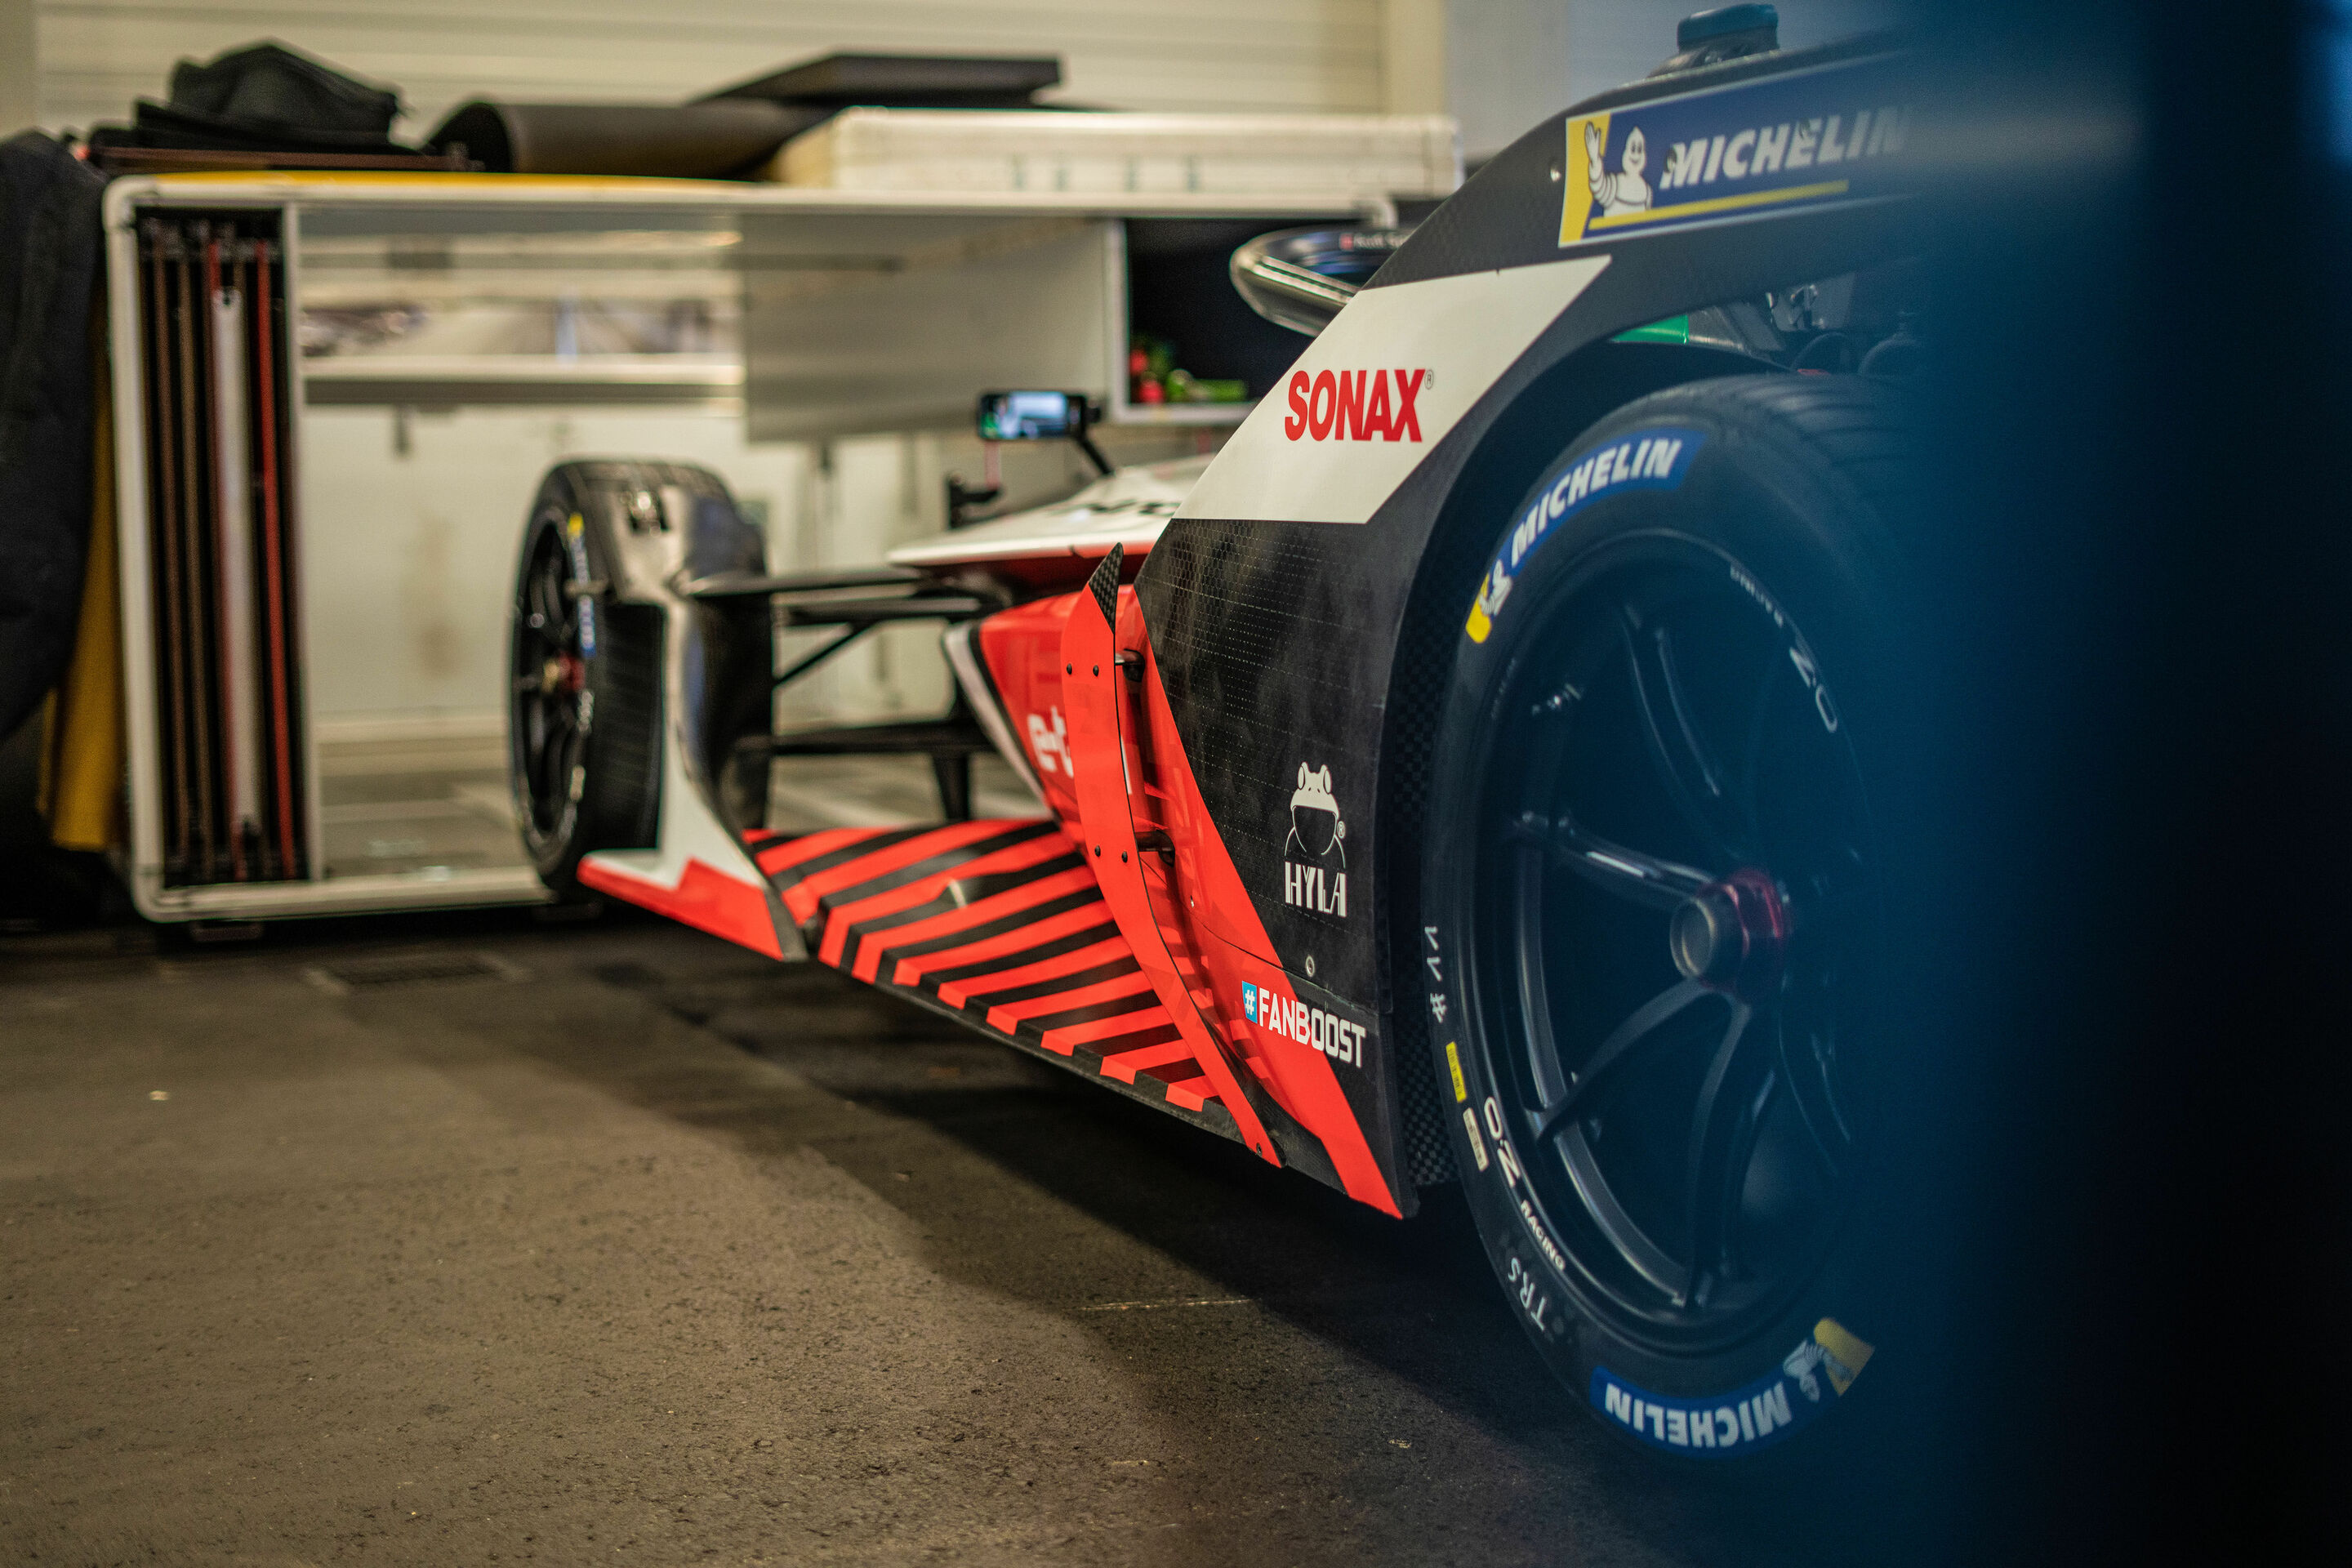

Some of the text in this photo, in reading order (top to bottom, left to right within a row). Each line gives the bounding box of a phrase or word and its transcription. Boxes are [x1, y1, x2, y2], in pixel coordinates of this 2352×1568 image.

[1659, 106, 1909, 190] MICHELIN
[1511, 439, 1682, 568] MICHELIN
[1284, 861, 1348, 918] HYLA
[1520, 1199, 1566, 1271] RACING
[1507, 1256, 1548, 1332] TRS
[1604, 1380, 1793, 1449] MICHELIN
